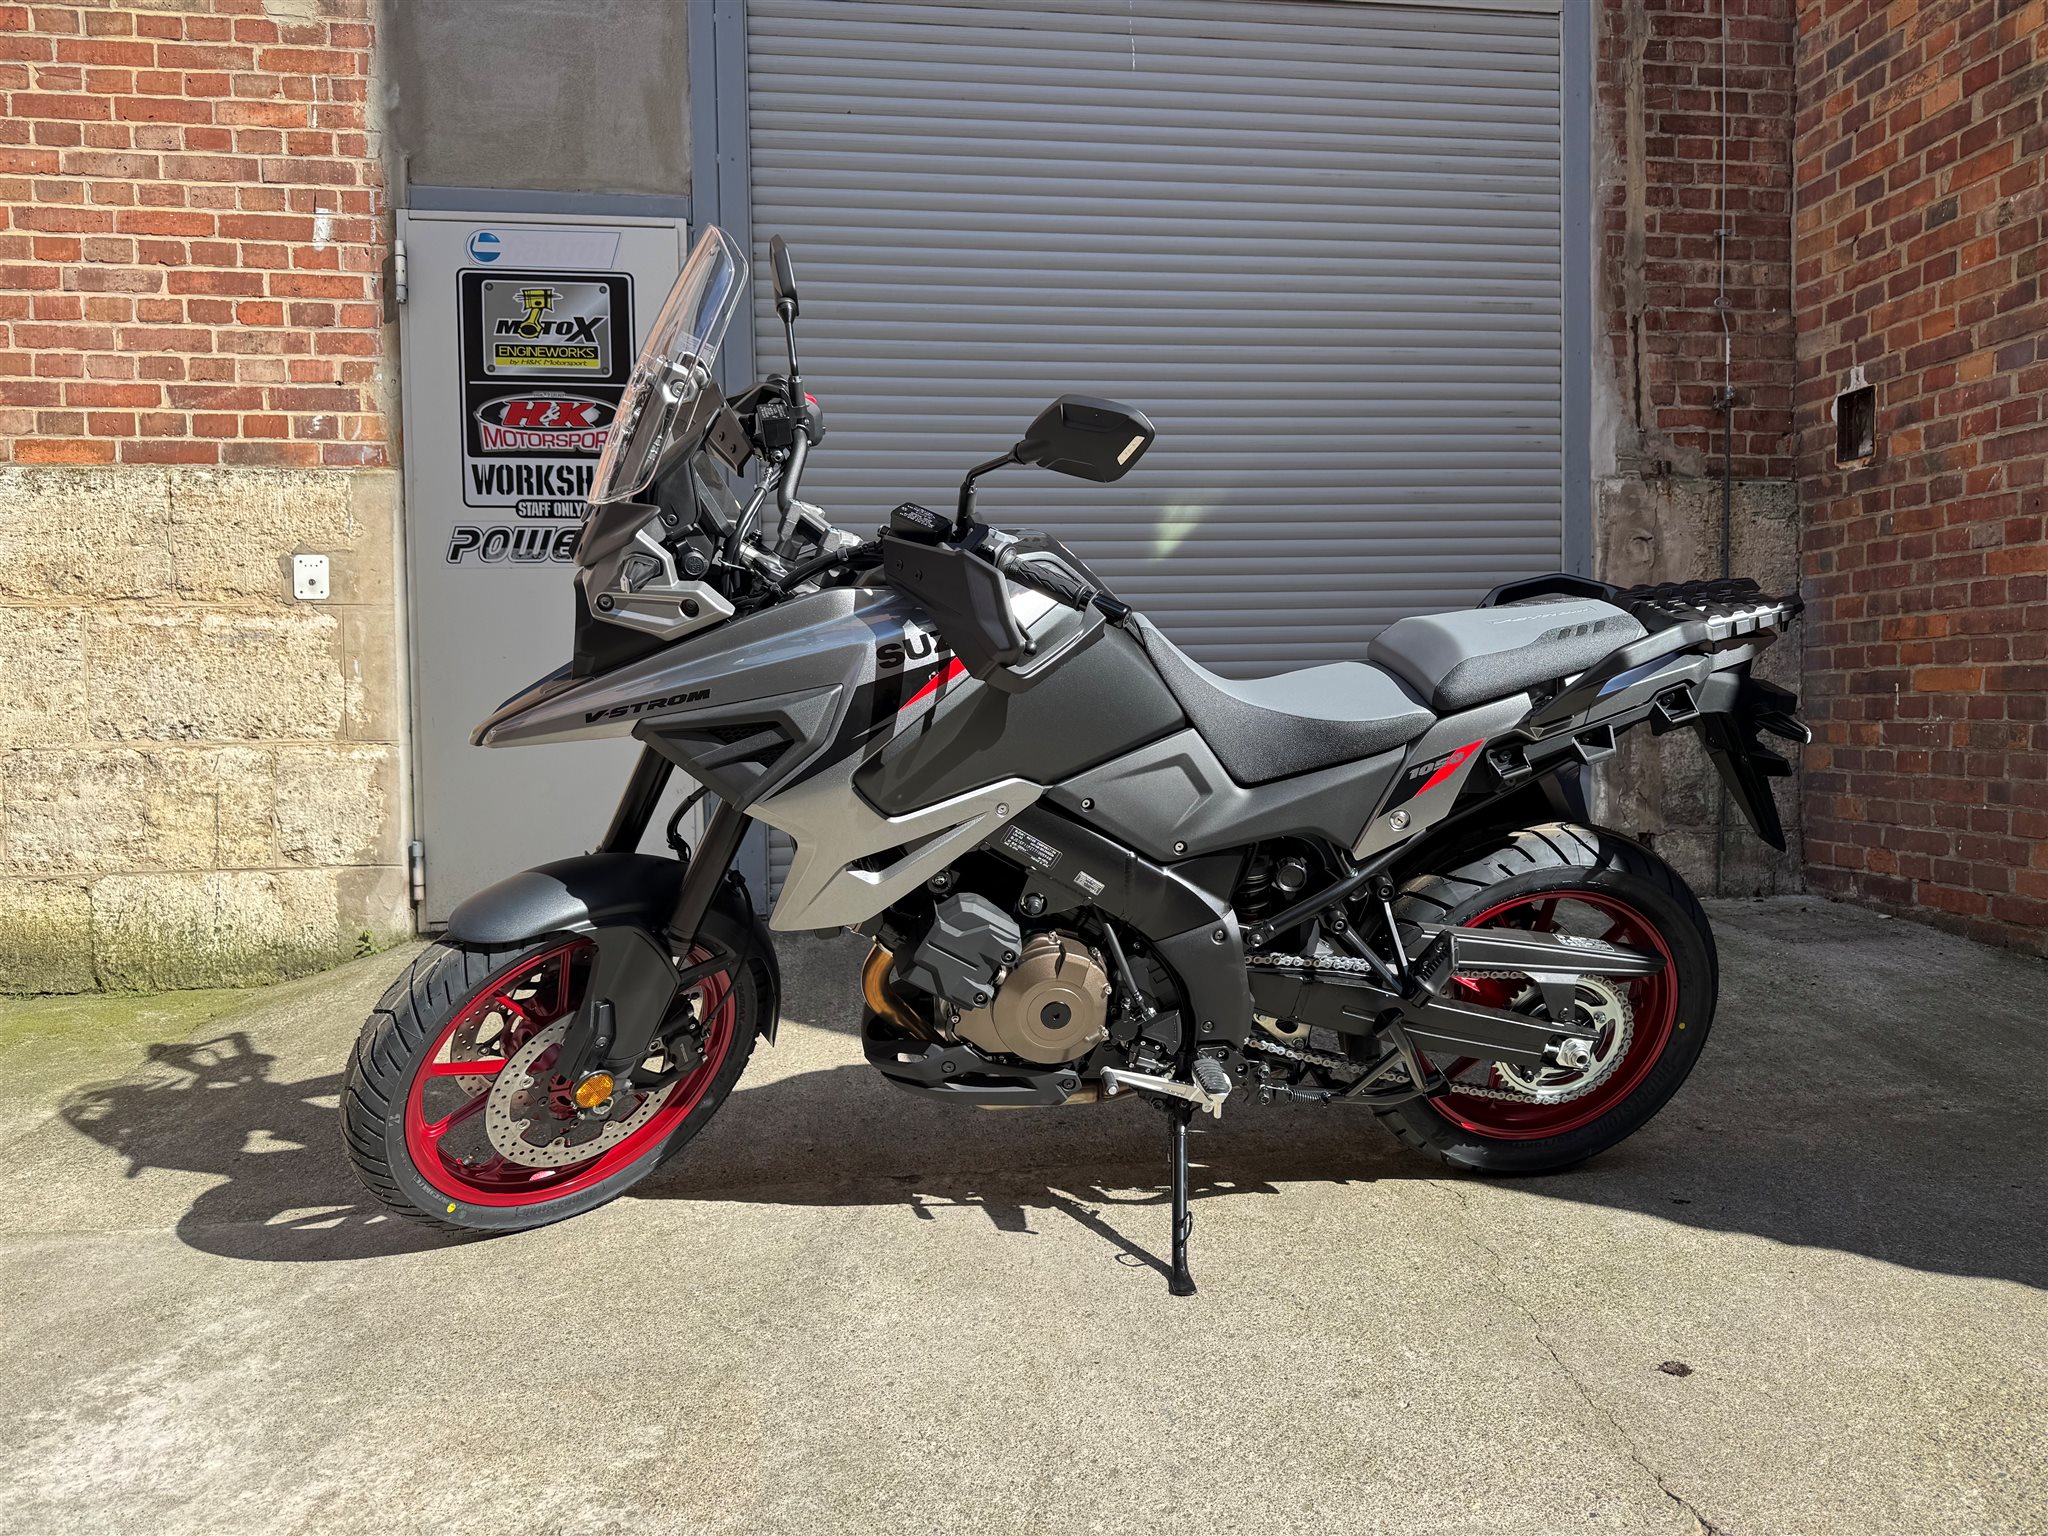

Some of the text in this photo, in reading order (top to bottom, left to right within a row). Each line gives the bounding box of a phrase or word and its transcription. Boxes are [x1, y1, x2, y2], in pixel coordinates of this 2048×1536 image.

[499, 346, 595, 358] ENGINEWORKS
[502, 401, 596, 427] H&K
[483, 425, 608, 449] MOTORSPOR
[471, 464, 594, 496] WORKSH
[518, 502, 551, 517] STAFF
[447, 526, 582, 563] POWE
[876, 630, 952, 669] SUZ
[585, 688, 711, 723] V-STROM
[1409, 751, 1464, 780] 1050
